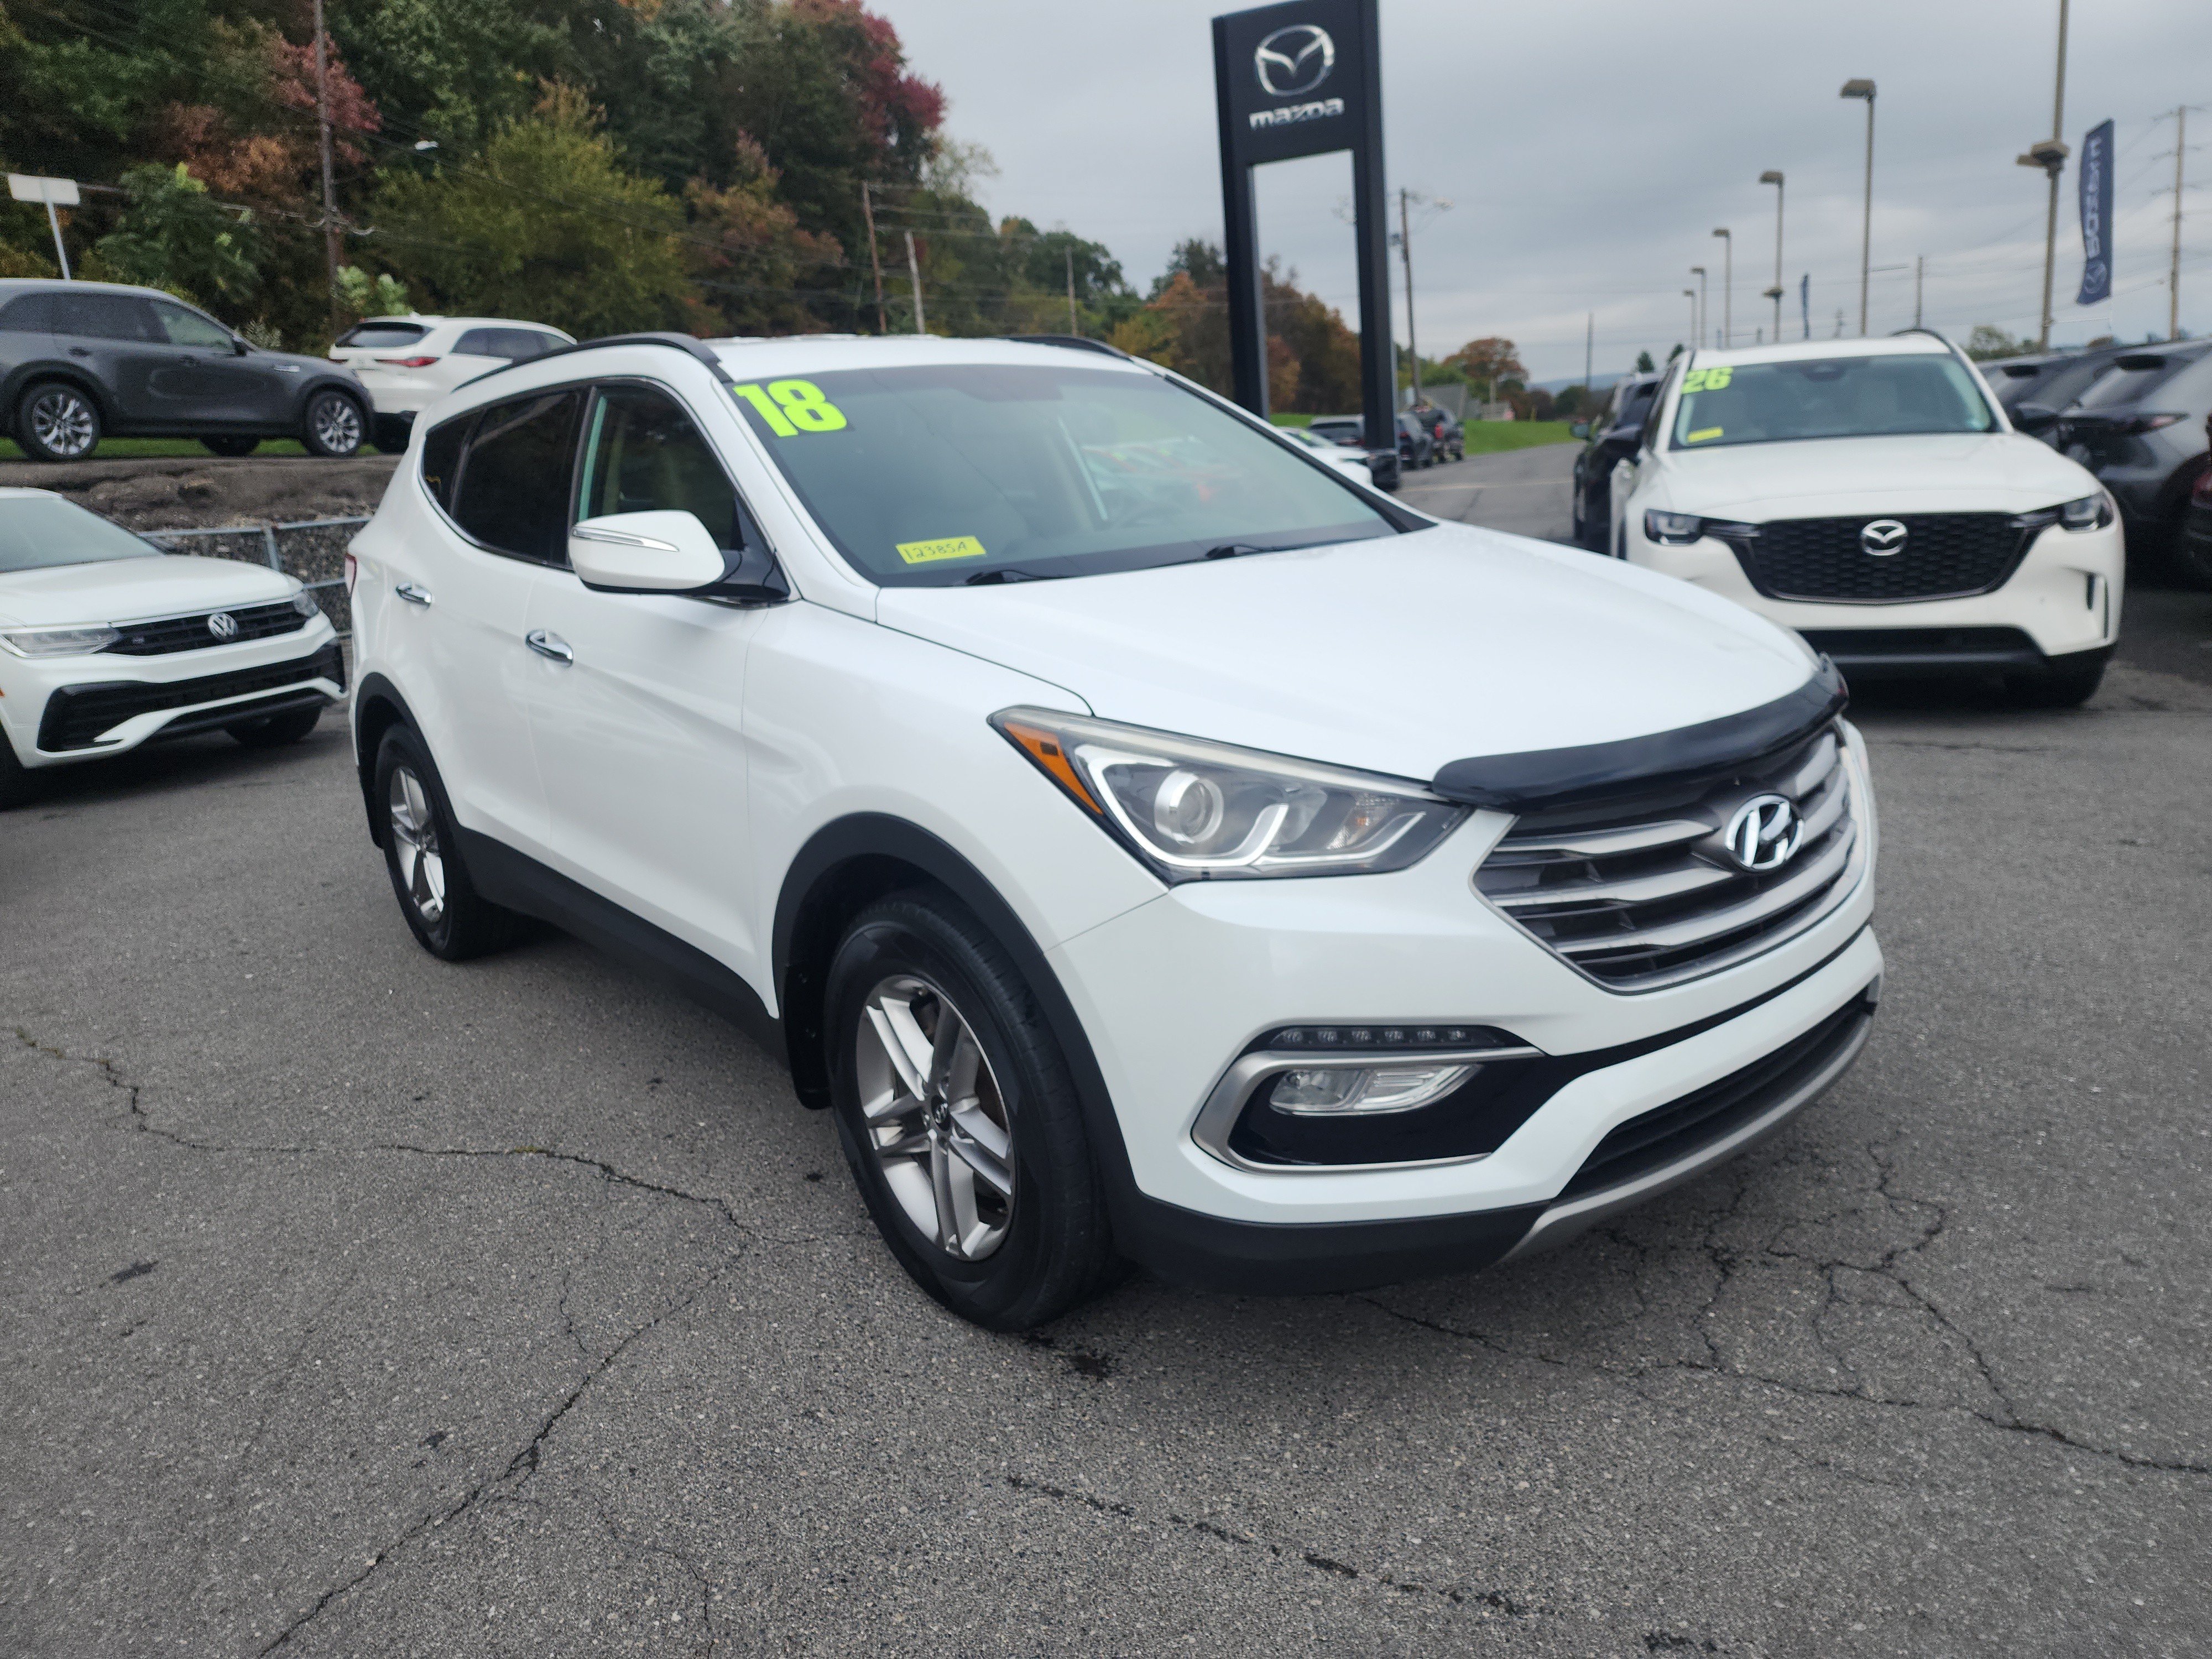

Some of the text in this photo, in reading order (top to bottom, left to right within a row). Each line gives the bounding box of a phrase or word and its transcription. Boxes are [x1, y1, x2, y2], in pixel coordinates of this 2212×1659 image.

[1249, 97, 1344, 129] mazda
[1681, 367, 1733, 394] 26
[732, 379, 848, 437] 18
